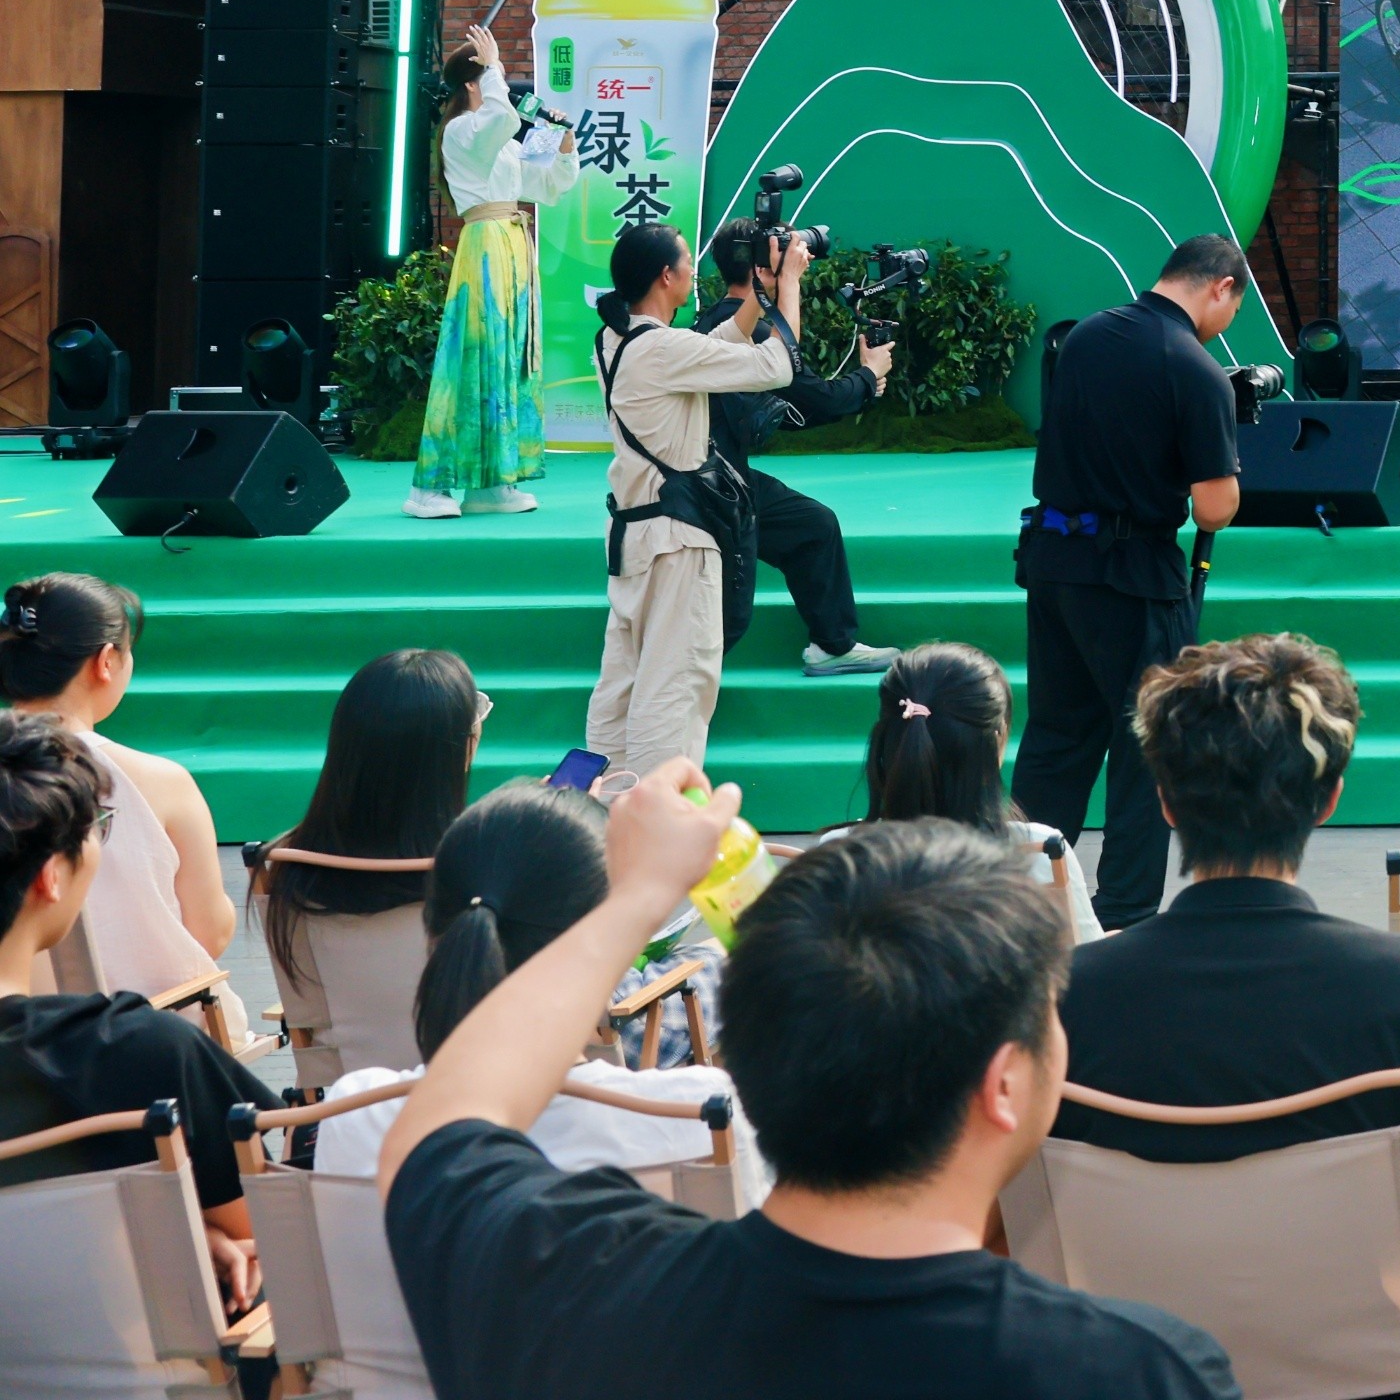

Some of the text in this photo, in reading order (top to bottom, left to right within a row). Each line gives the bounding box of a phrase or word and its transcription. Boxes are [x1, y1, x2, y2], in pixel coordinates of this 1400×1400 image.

[553, 44, 571, 86] 低糖
[598, 79, 651, 99] 统一
[864, 284, 886, 297] RONIN
